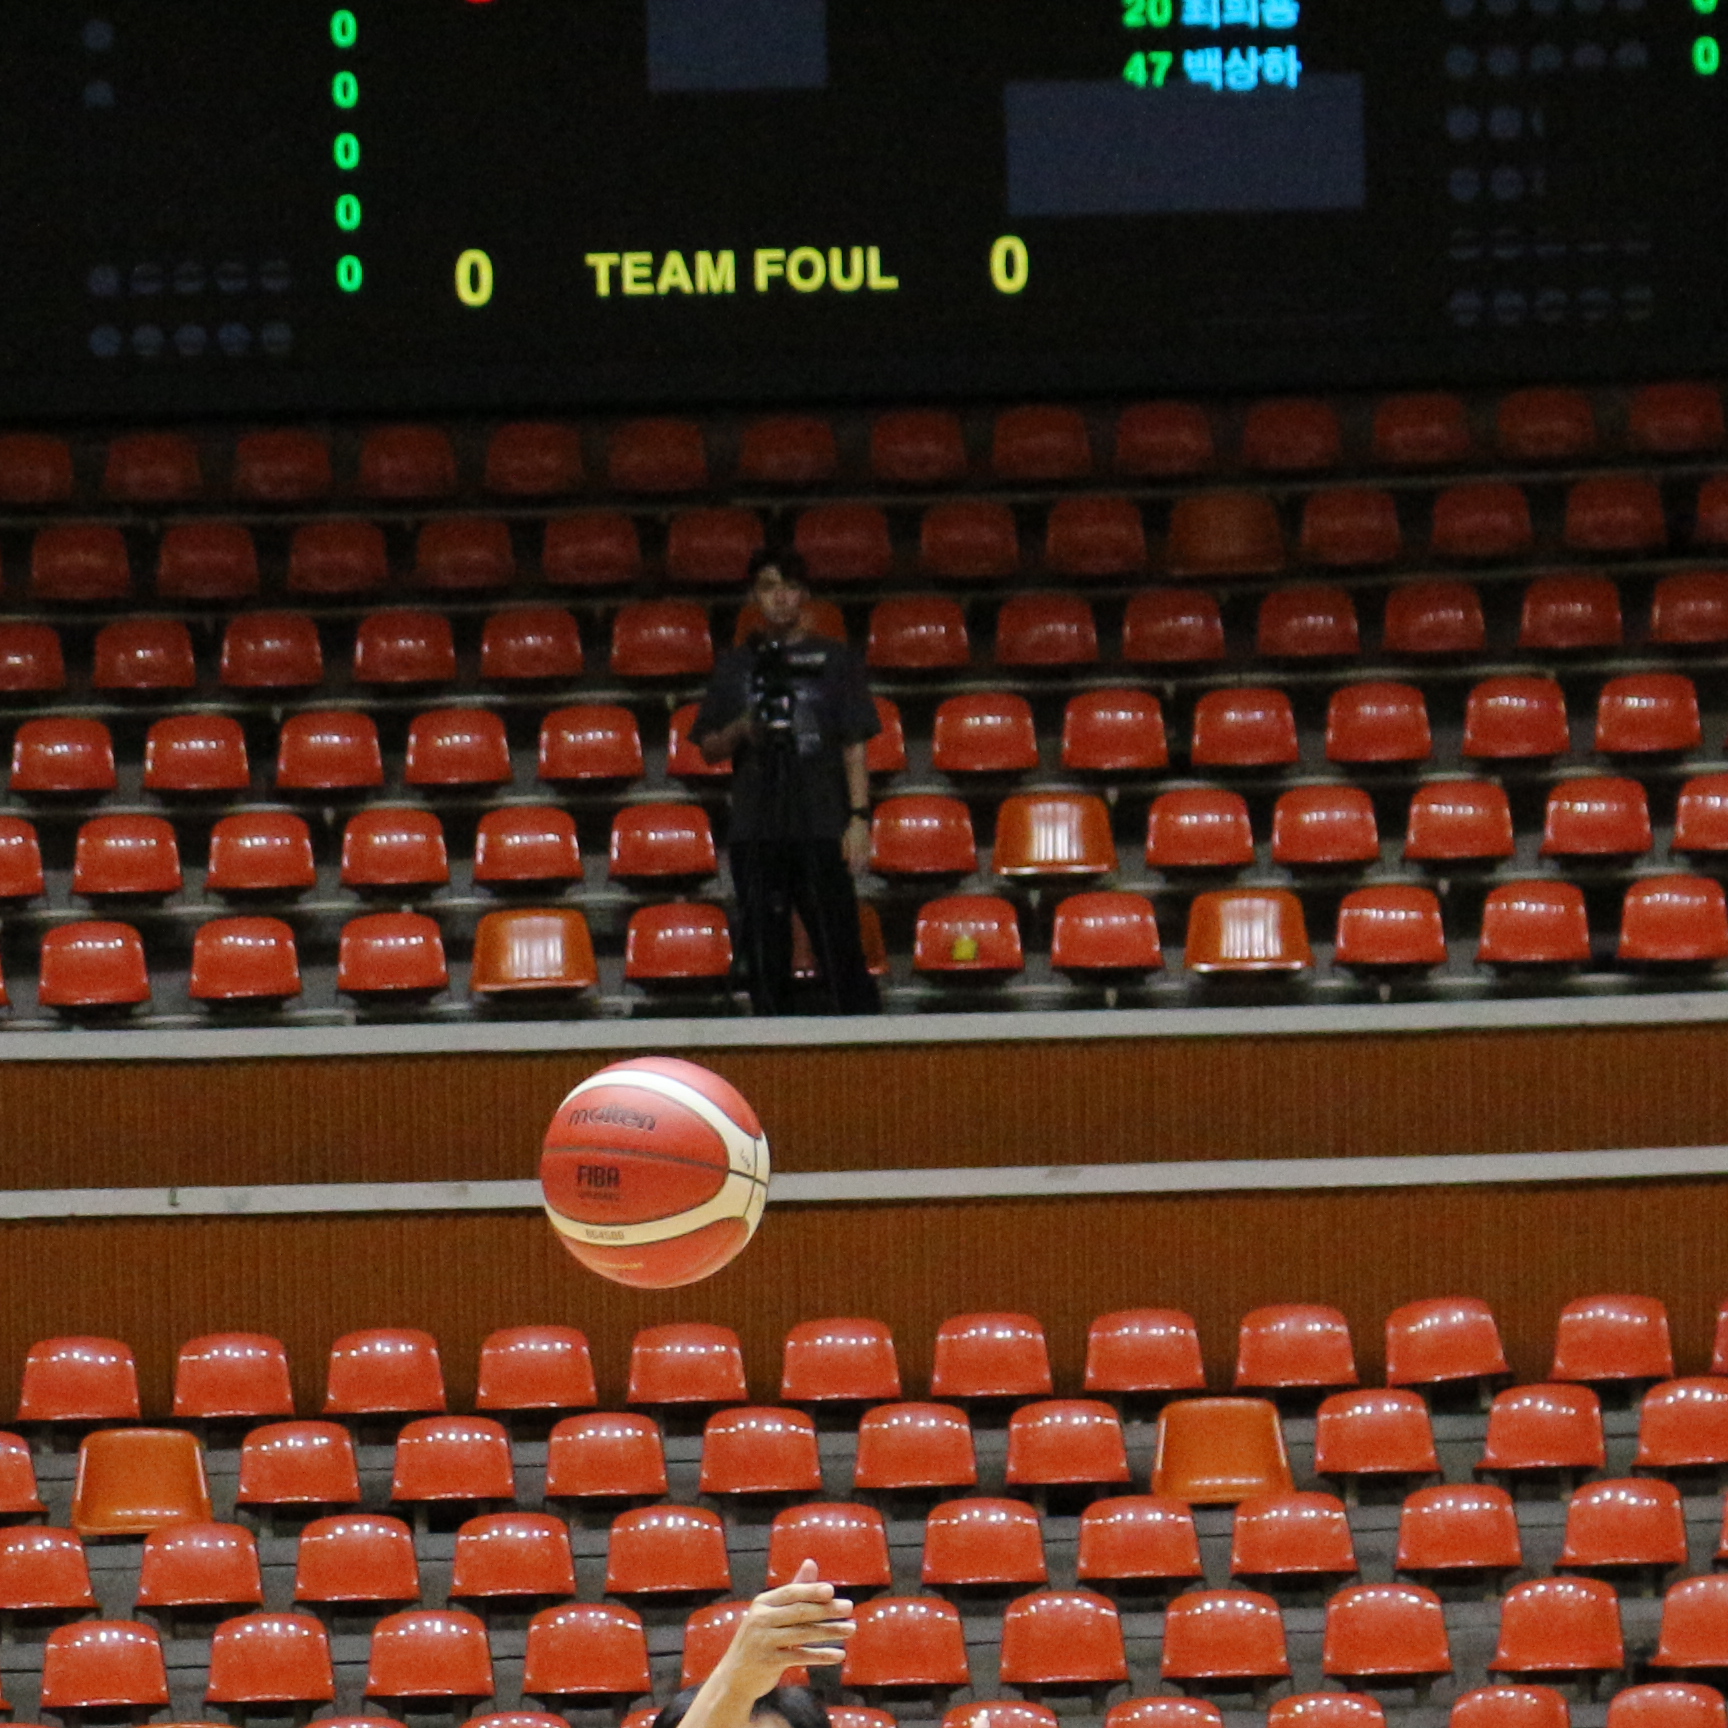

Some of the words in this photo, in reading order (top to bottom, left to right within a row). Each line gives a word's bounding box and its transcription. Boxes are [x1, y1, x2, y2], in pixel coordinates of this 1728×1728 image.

[331, 10, 357, 48] 0
[1123, 50, 1172, 88] 47
[1692, 36, 1719, 75] 0
[333, 71, 359, 109] 0
[334, 132, 360, 170] 0
[336, 193, 362, 231] 0
[337, 255, 363, 292] 0
[455, 249, 493, 306] 0
[586, 250, 736, 297] TEAM
[755, 247, 898, 293] FOUL
[990, 236, 1029, 294] 0
[569, 1105, 656, 1132] molten
[577, 1165, 620, 1188] FIBA
